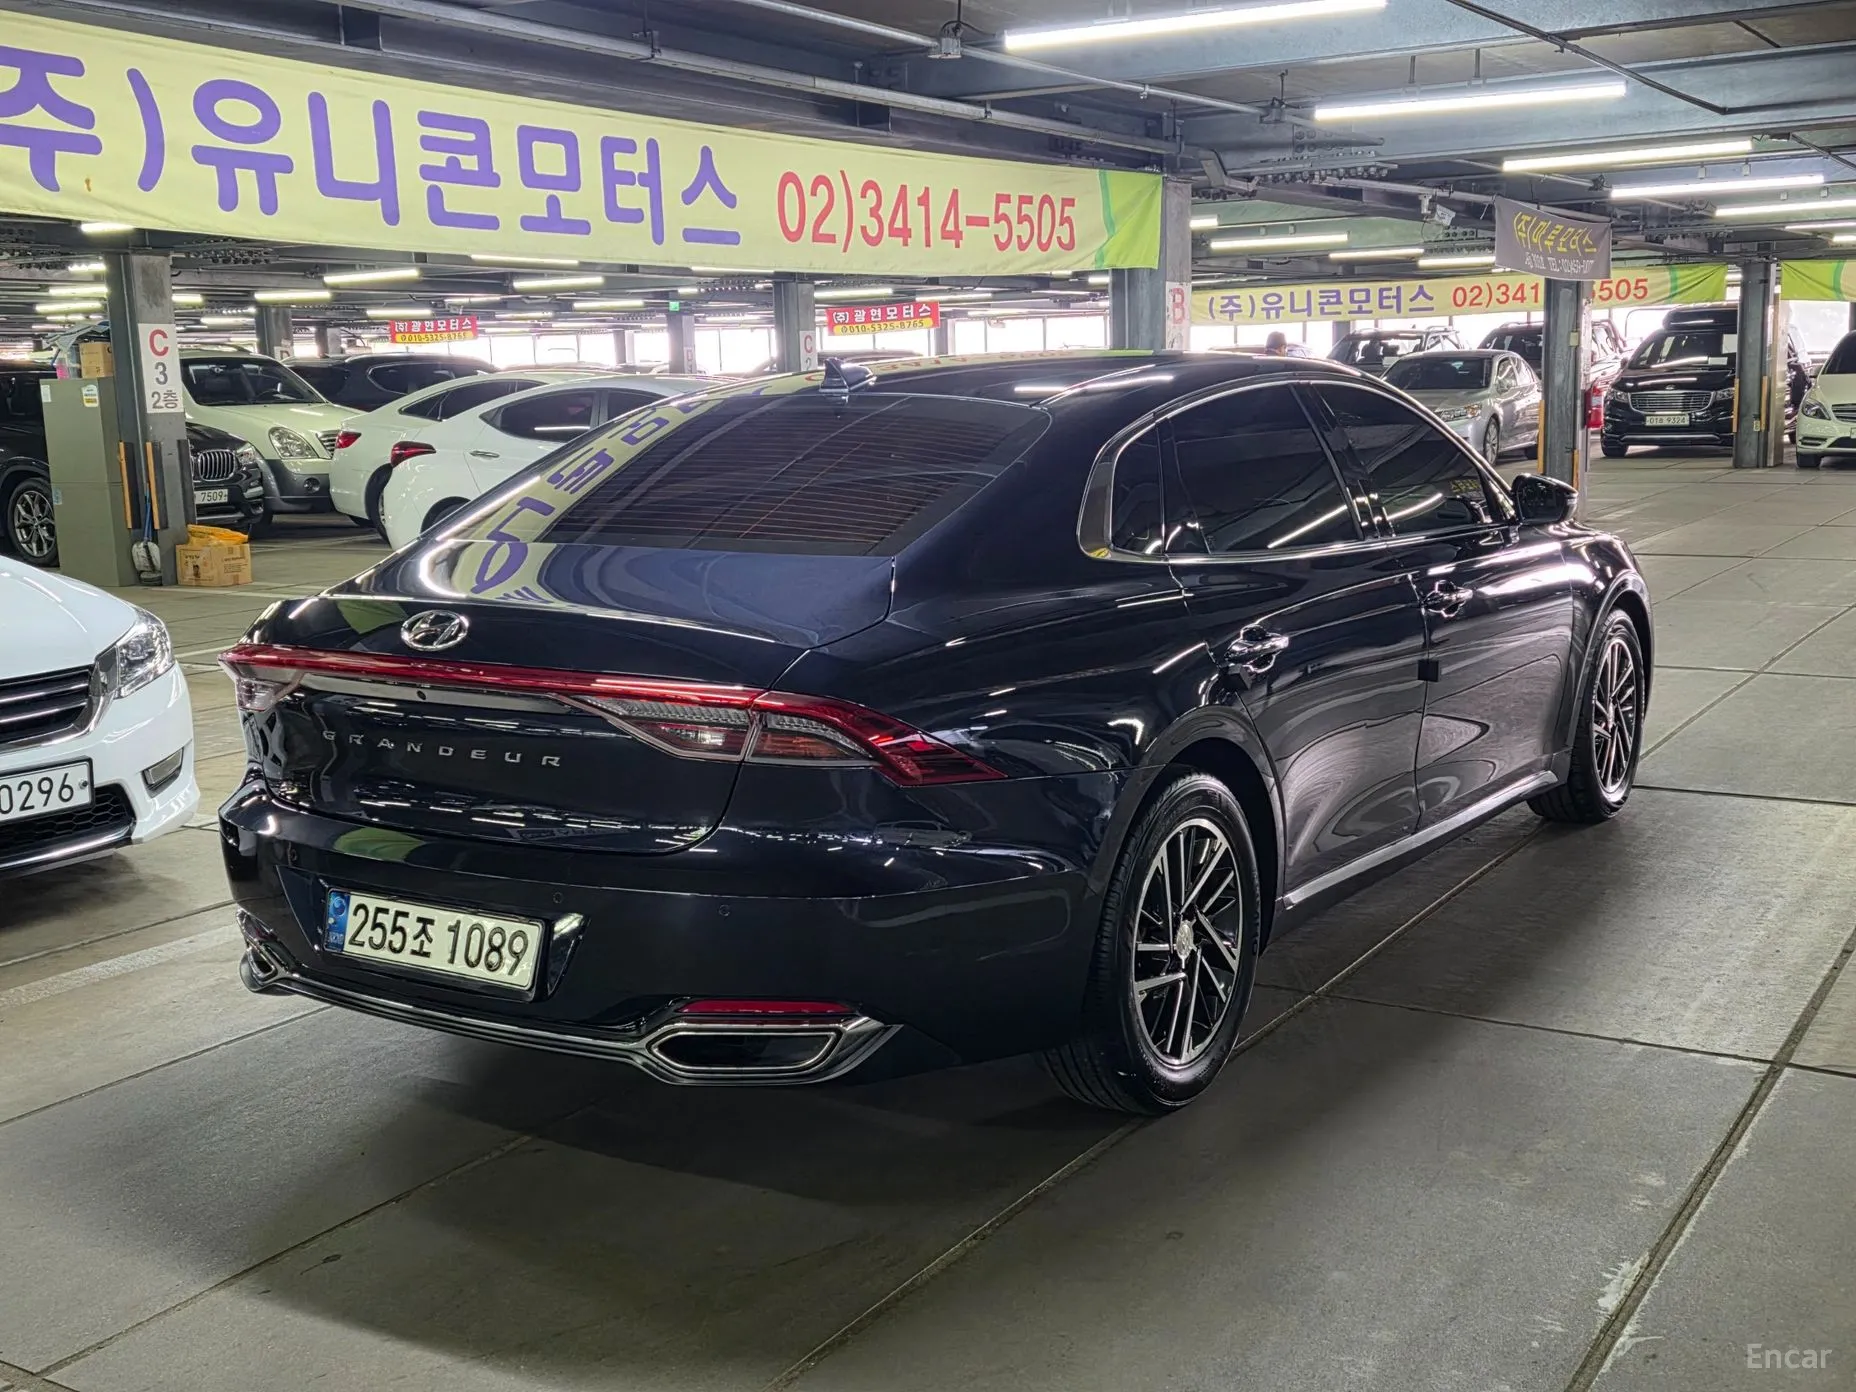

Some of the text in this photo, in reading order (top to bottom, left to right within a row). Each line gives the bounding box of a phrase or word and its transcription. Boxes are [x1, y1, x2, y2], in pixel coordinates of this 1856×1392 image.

[777, 170, 1076, 253] 02)3414-5505
[1208, 284, 1435, 322] (주)유니콘모터스
[849, 319, 924, 334] 010-5325-8765
[149, 329, 169, 357] C
[804, 335, 813, 353] C
[154, 361, 168, 385] 3
[151, 390, 179, 409] 2층
[200, 490, 224, 502] 7509
[322, 729, 561, 767] GRANDEUR
[0, 772, 74, 814] 0296
[348, 903, 529, 976] 255조 1089
